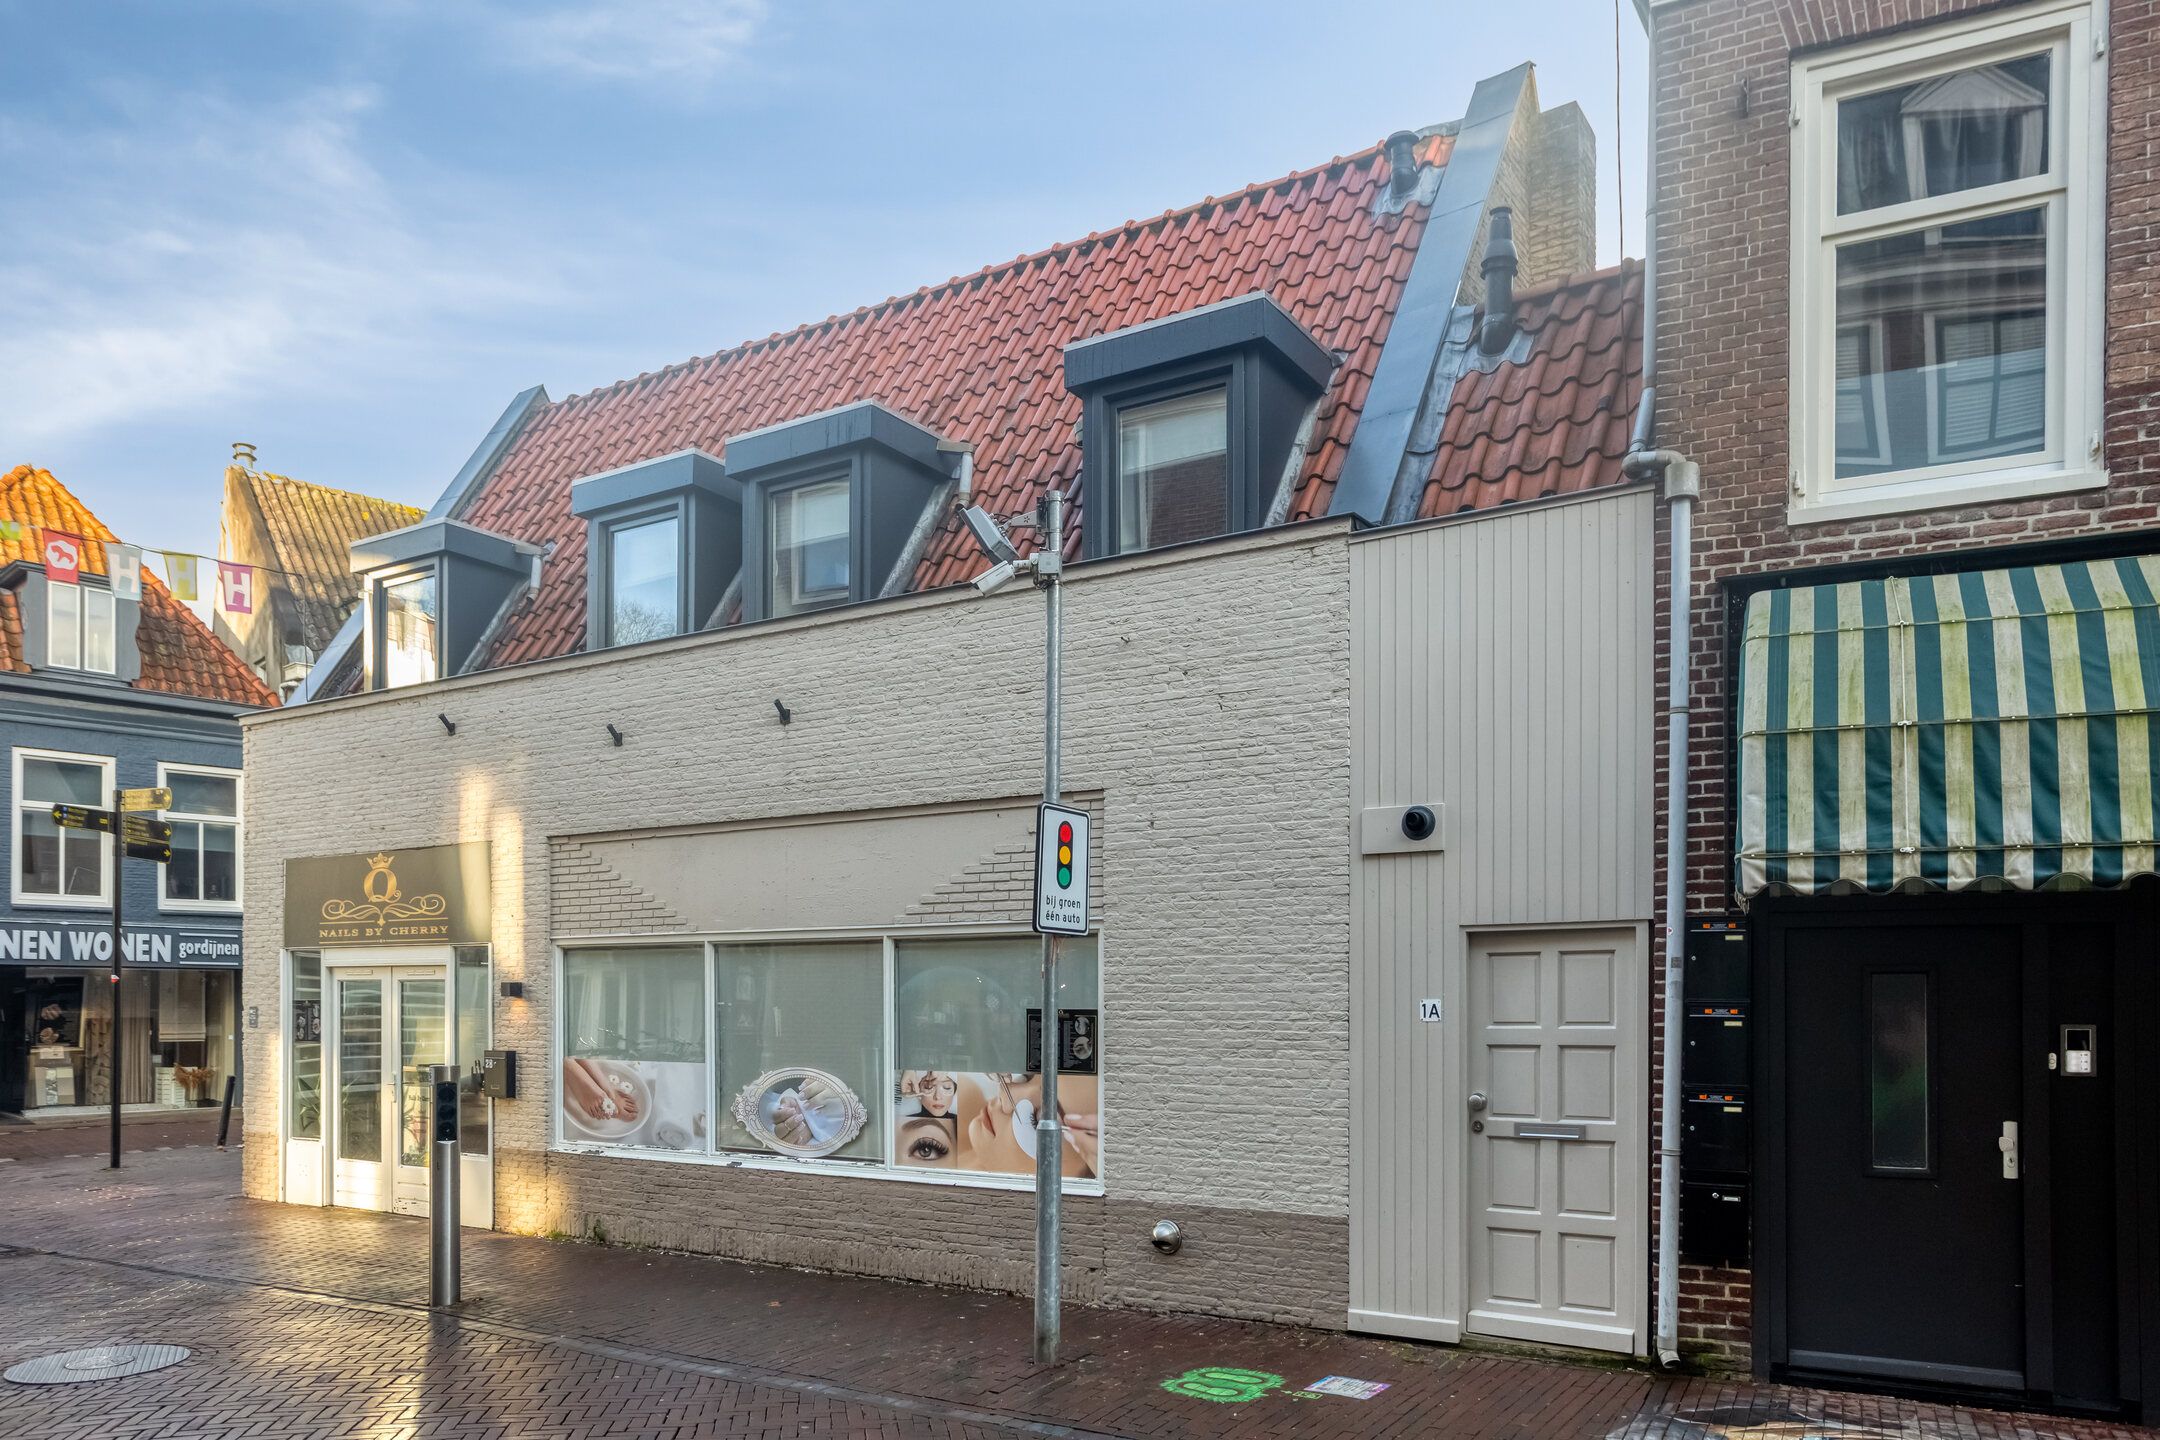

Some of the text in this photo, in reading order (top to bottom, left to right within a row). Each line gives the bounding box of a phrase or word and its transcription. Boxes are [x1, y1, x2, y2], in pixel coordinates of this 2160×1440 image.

[223, 570, 251, 608] H
[1046, 895, 1081, 910] bij groen
[1045, 910, 1081, 924] één auto
[319, 925, 448, 938] NAILS BY CHERRY
[178, 939, 240, 959] gordijnen
[1421, 1003, 1440, 1018] 1A
